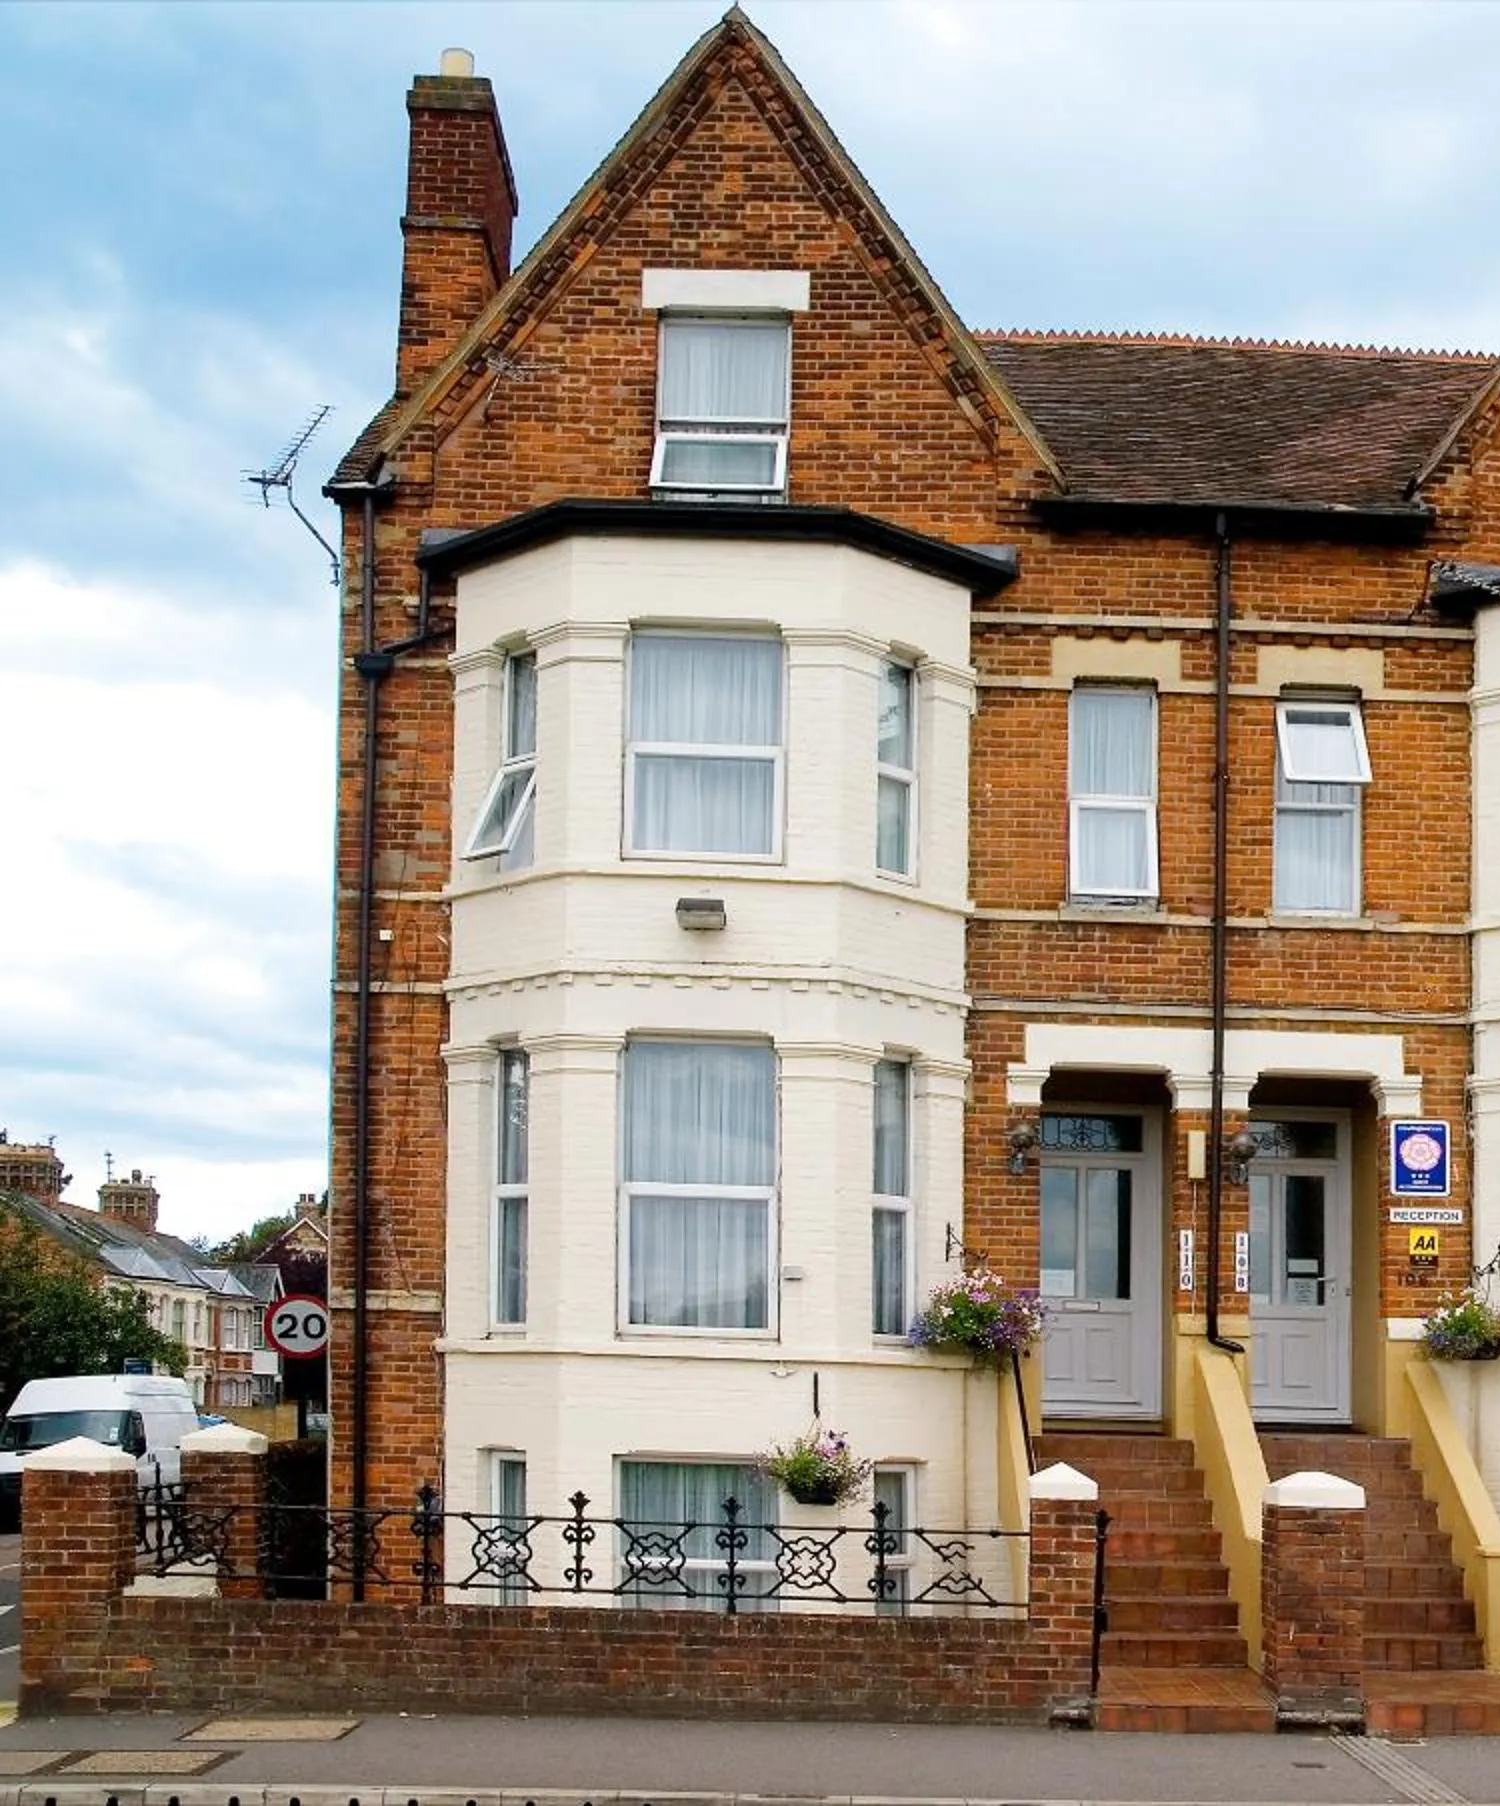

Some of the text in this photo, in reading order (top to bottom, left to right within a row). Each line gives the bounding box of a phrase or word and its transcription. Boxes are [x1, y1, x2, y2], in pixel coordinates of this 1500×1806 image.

[1393, 1211, 1459, 1221] RECEPTION
[1414, 1236, 1435, 1250] AA
[277, 1313, 326, 1339] 20
